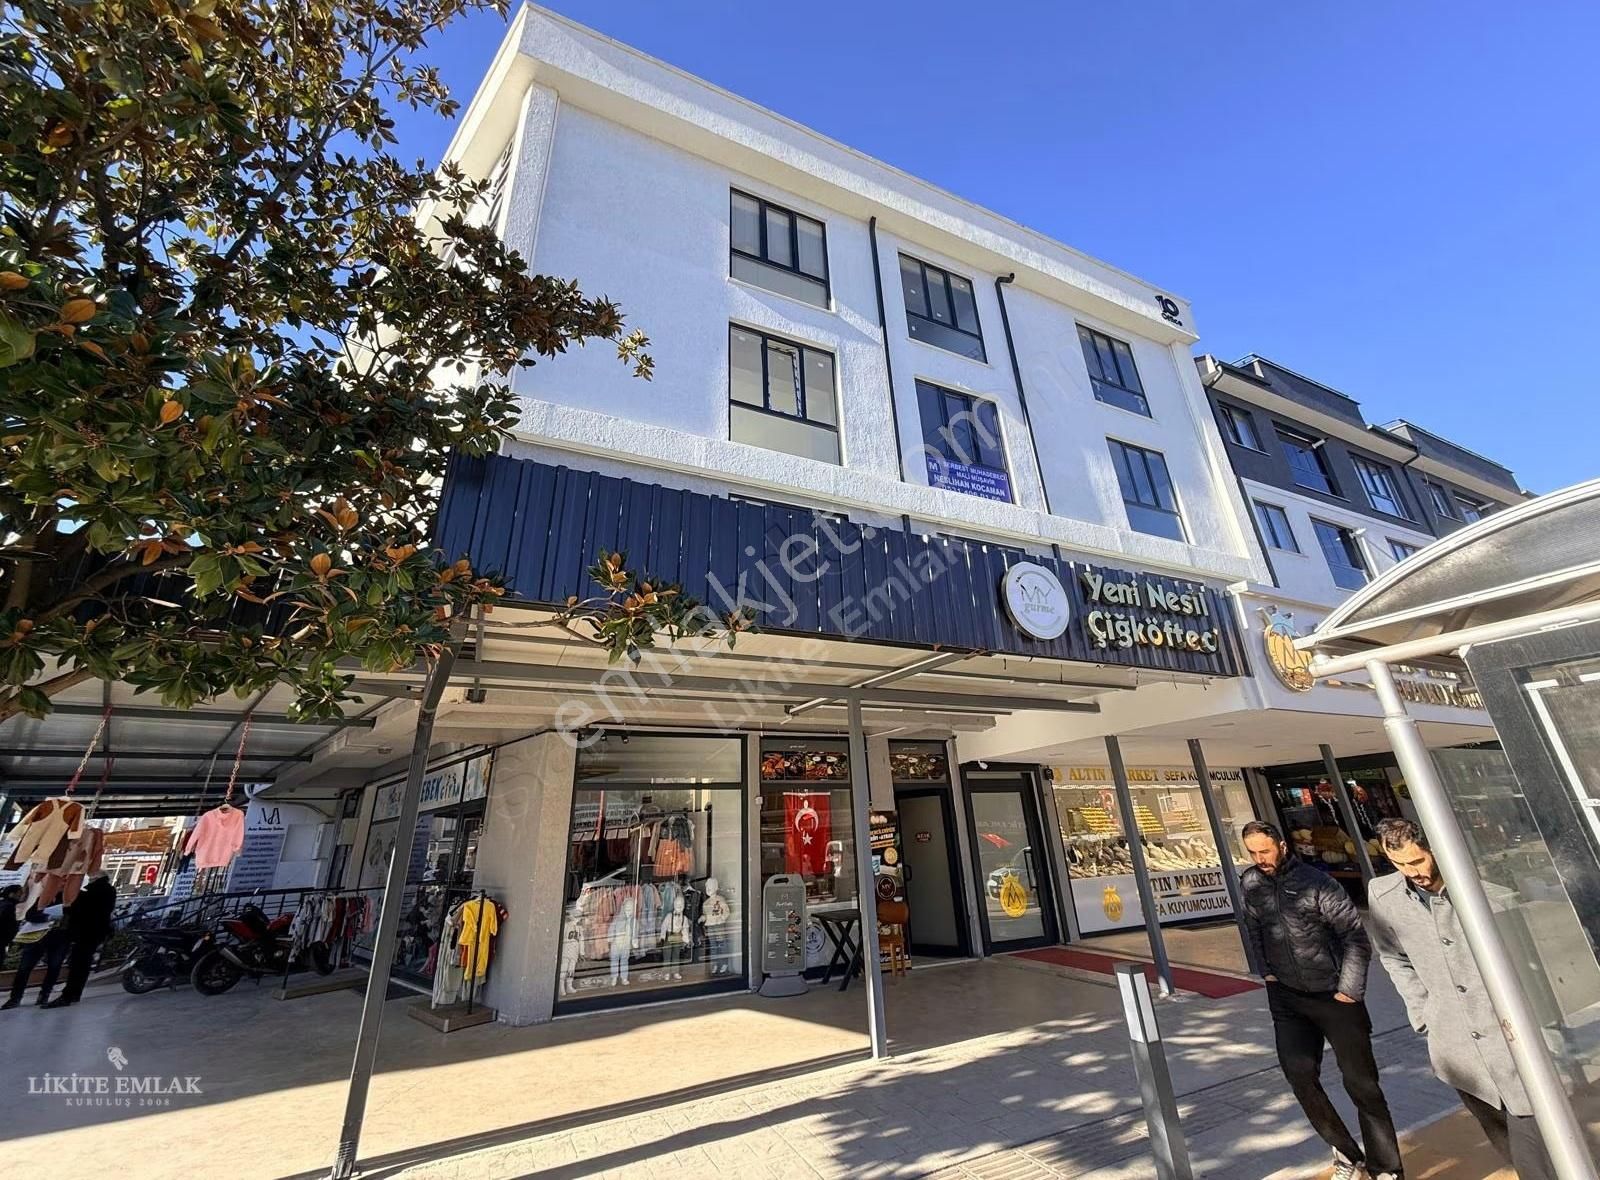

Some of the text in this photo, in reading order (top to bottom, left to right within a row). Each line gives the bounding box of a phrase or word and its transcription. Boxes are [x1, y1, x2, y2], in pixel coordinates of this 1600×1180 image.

[970, 482, 1006, 497] KOCAMAN
[1084, 572, 1210, 617] Yeni Nesil
[1024, 603, 1055, 614] gurme
[1069, 767, 1106, 782] ALTIN
[1164, 770, 1187, 782] SEFA
[1150, 872, 1223, 894] TIN MARKET
[1168, 898, 1231, 916] KUYUMCULUK
